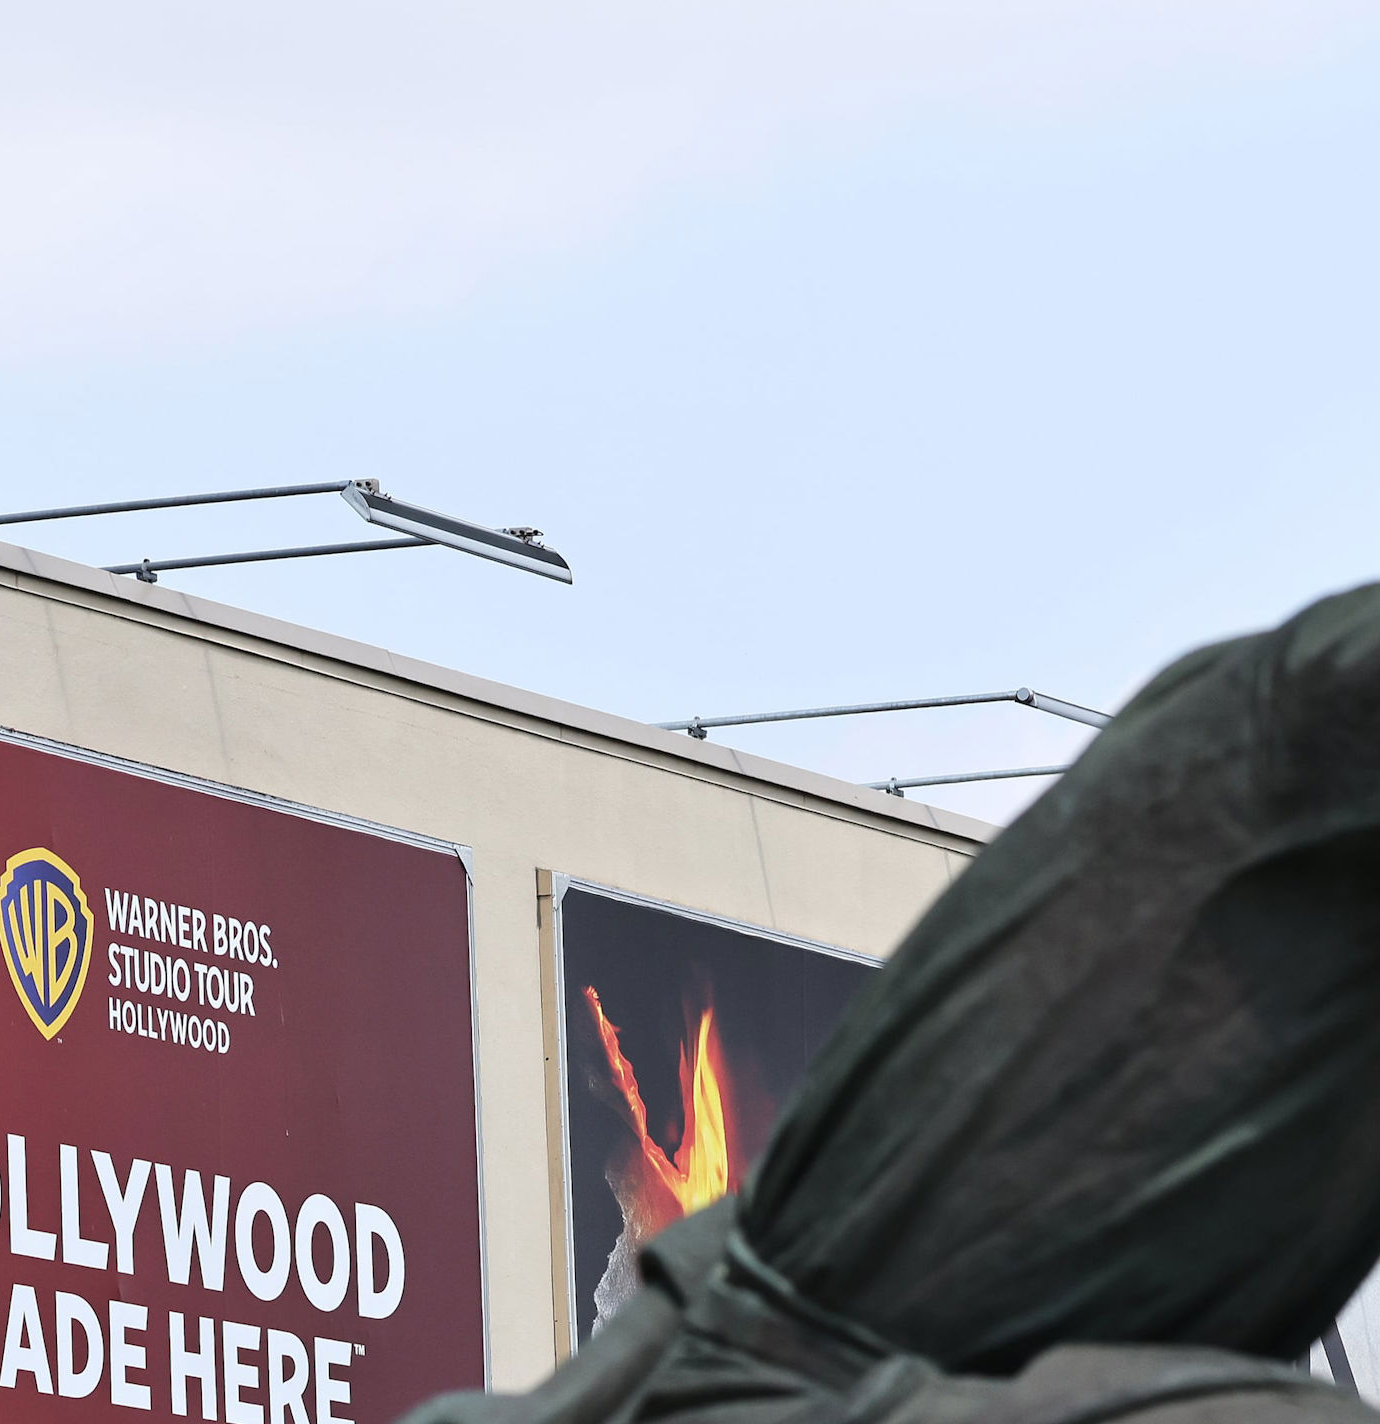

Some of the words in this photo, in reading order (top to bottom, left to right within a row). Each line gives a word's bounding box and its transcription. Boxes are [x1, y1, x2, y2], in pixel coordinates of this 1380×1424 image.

[105, 887, 207, 952] WARNER
[213, 912, 278, 969] BROS.
[107, 945, 190, 1001] STUDIO
[194, 962, 256, 1016] TOUR
[108, 997, 231, 1054] HOLLYWOOD
